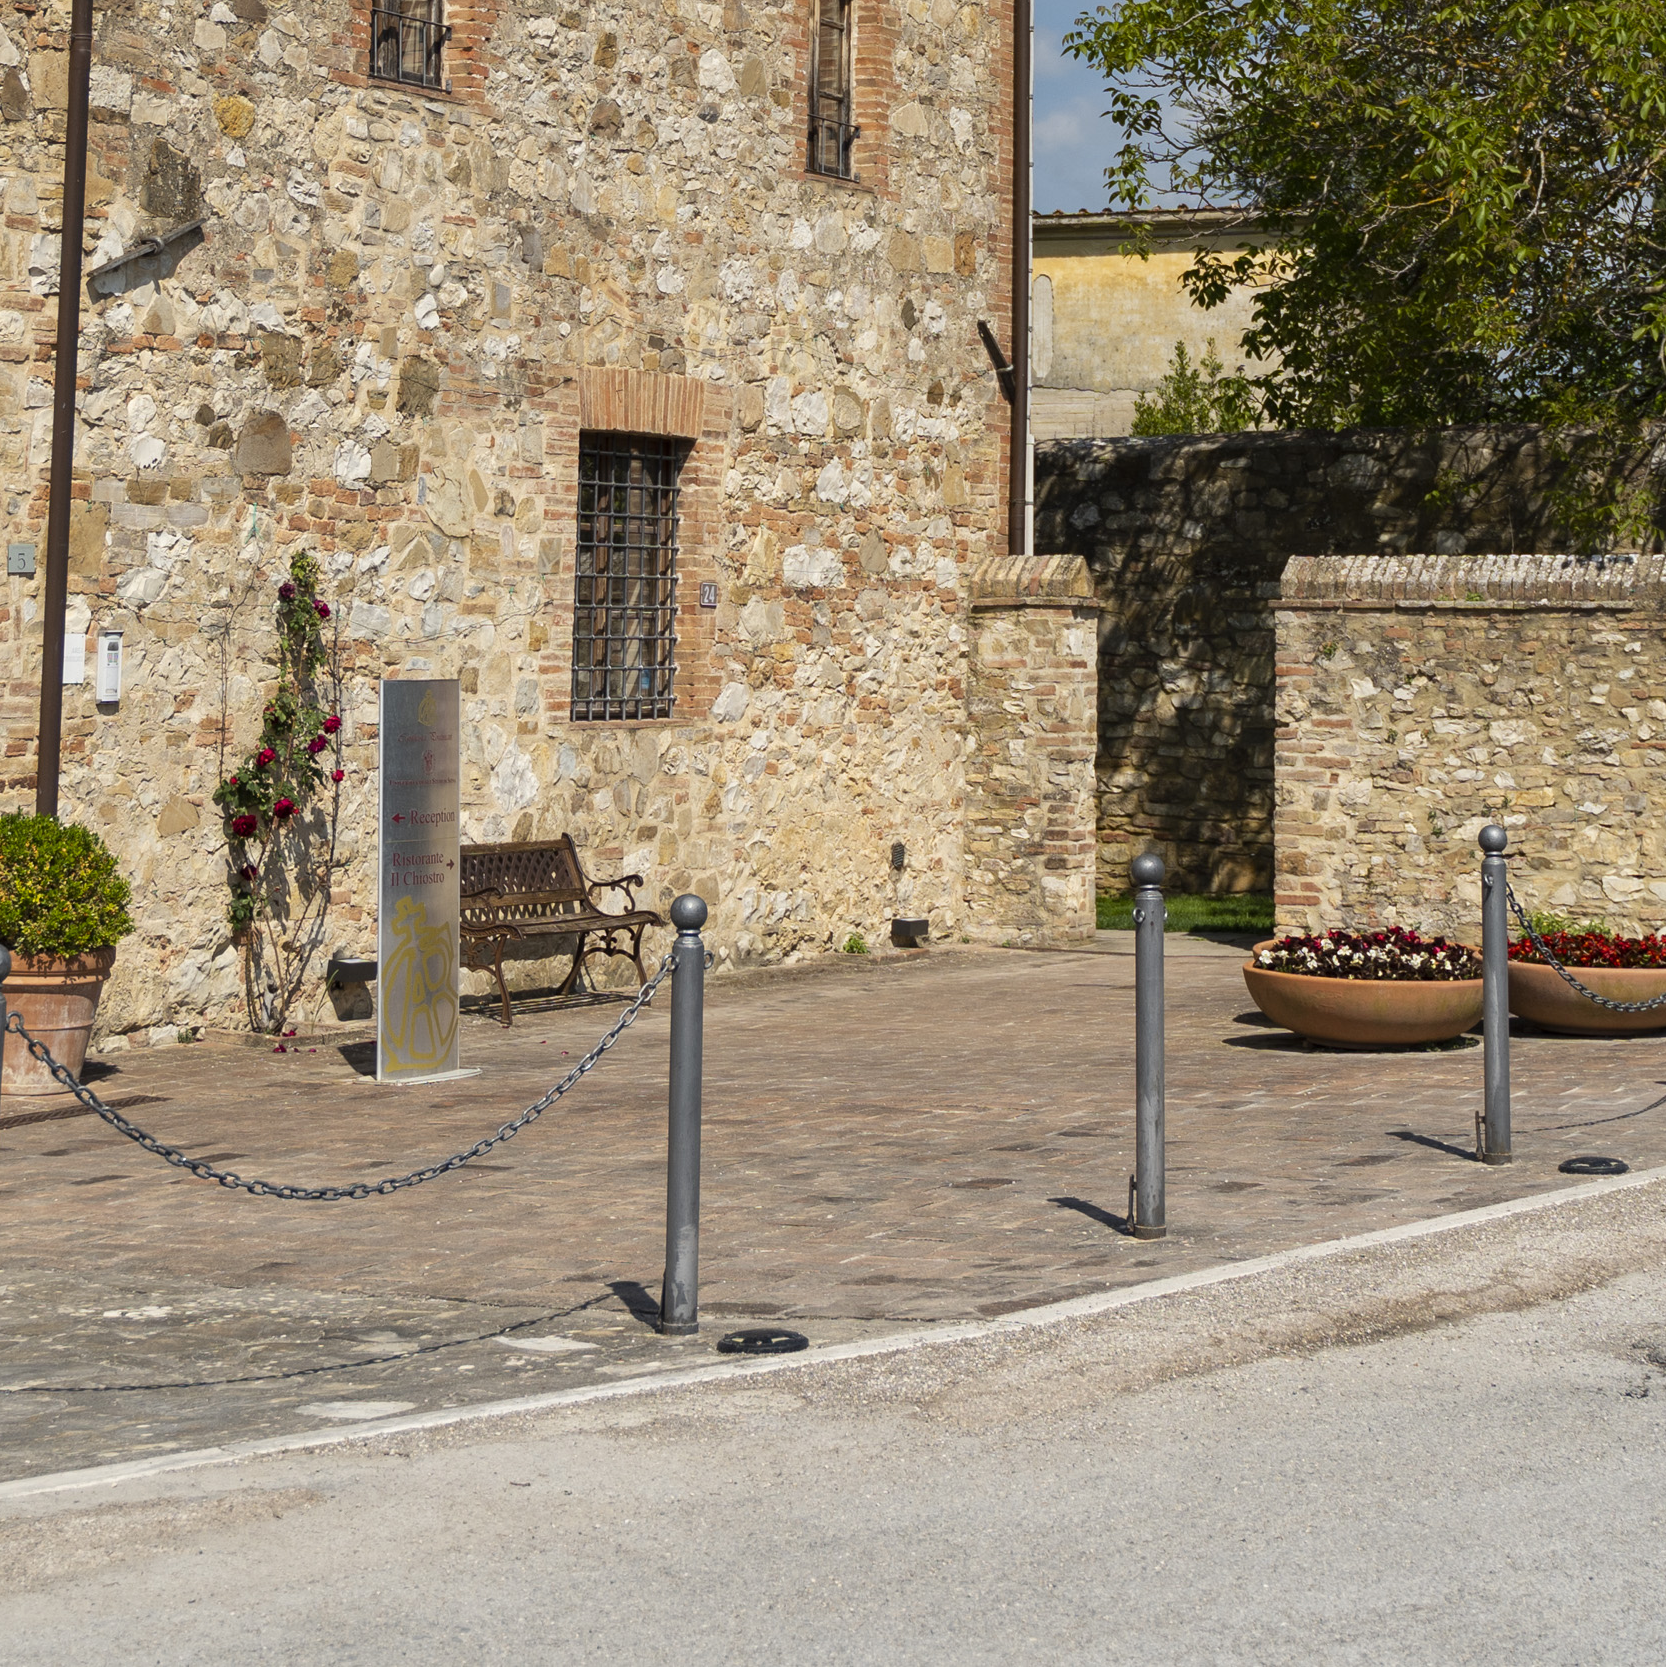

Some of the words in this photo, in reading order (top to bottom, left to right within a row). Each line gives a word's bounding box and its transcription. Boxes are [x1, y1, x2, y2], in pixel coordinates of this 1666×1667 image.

[17, 552, 26, 570] 5
[703, 585, 715, 603] 24
[410, 809, 455, 827] Reception
[392, 851, 444, 867] Ristorante
[391, 872, 399, 887] Il
[403, 870, 445, 886] Chiostro
